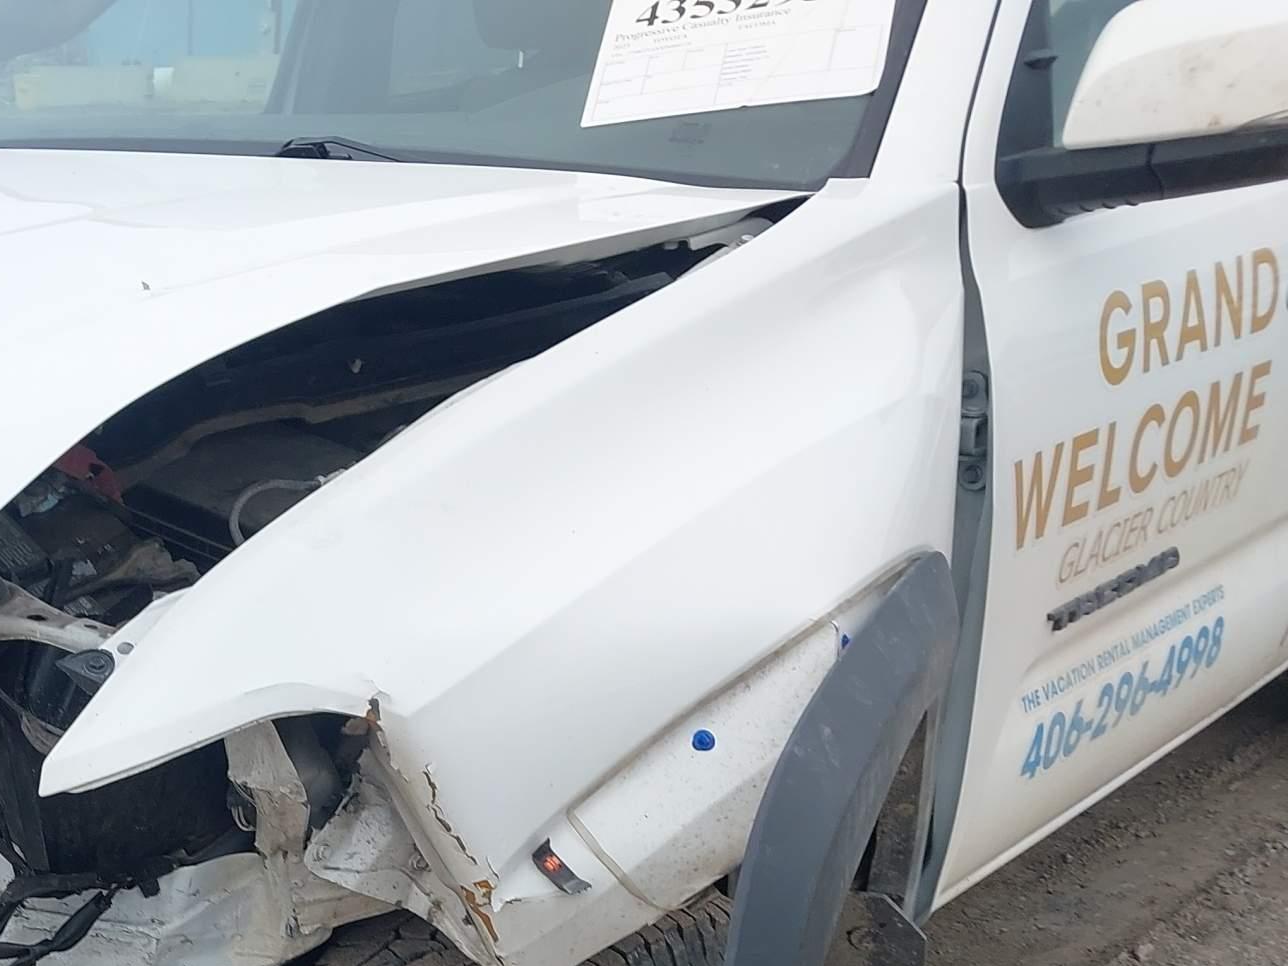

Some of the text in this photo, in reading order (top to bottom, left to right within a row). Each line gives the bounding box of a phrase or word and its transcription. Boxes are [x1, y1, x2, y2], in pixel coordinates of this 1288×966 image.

[1099, 247, 1280, 386] GRAND
[1014, 359, 1273, 551] WELCOME
[1058, 457, 1250, 584] GLACIER COUNTRY
[1020, 615, 1225, 780] 406-296-4998
[1021, 584, 1225, 713] THE VACATION RENTAL MANAGEMENT EXPERTS
